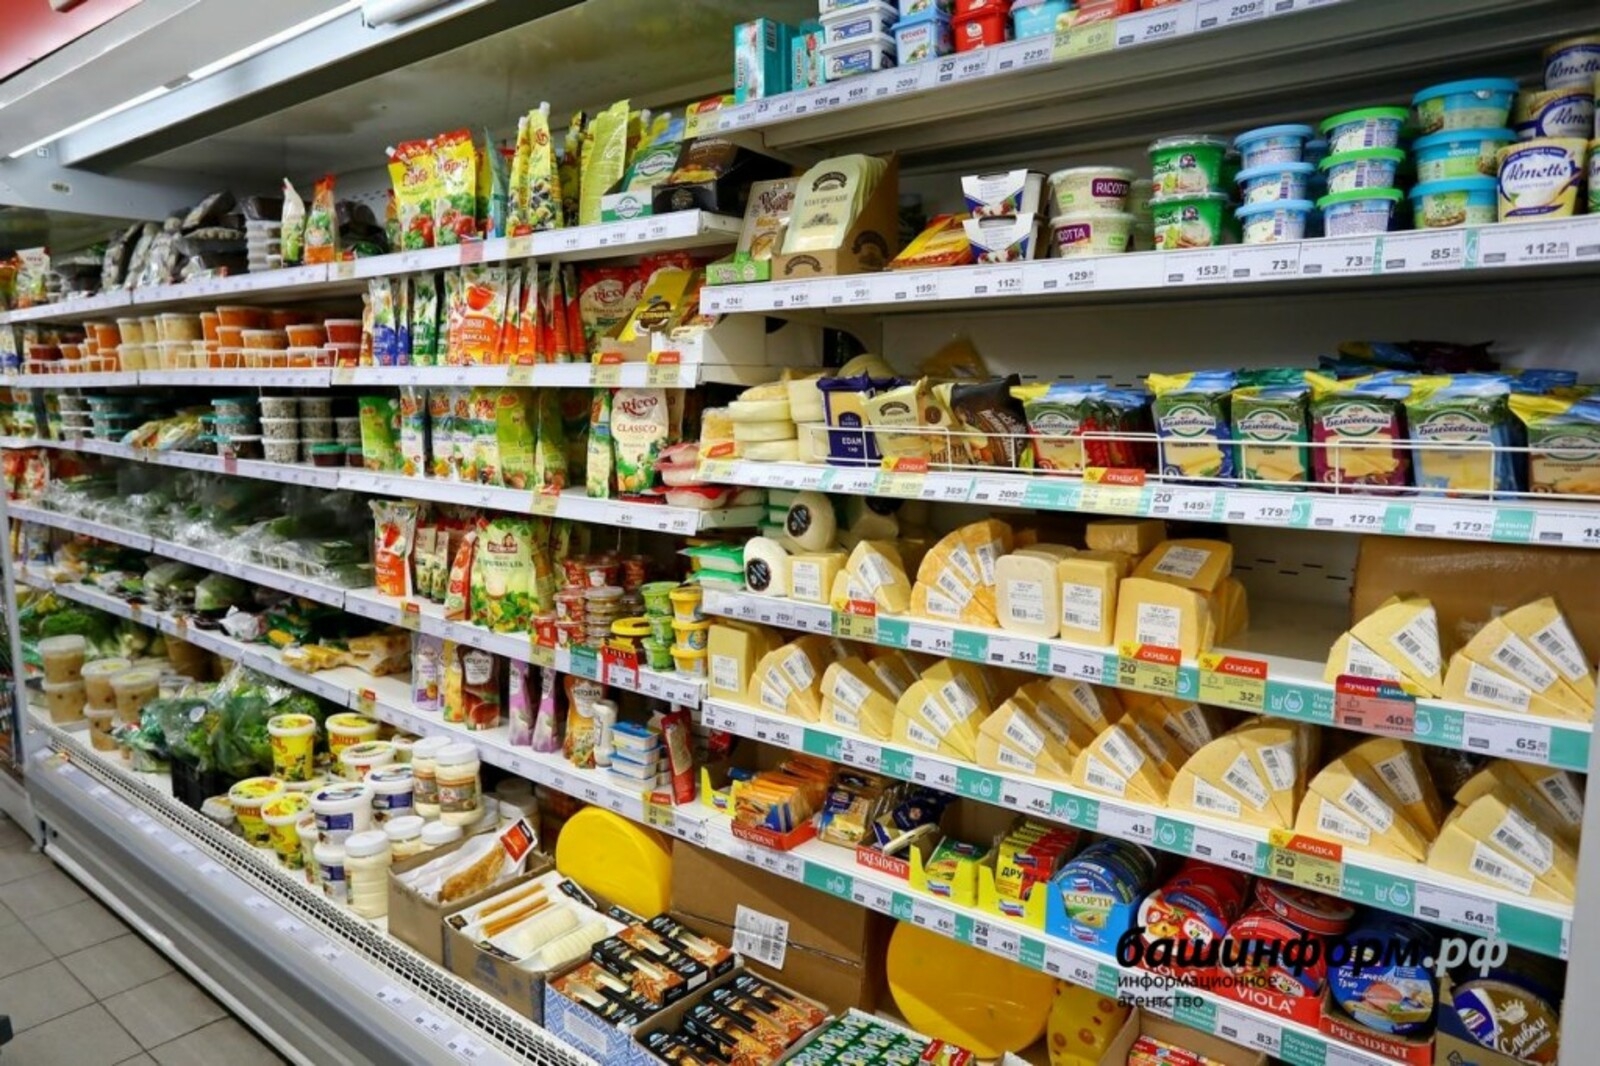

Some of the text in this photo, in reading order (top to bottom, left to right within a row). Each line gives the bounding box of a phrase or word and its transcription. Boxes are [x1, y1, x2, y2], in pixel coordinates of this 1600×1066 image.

[1504, 162, 1569, 182] Almette
[1430, 247, 1451, 260] 85
[1525, 242, 1558, 256] 112
[1272, 259, 1288, 271] 73
[1345, 255, 1363, 267] 73
[1418, 424, 1489, 436] Белебеевский
[1143, 650, 1176, 663] СКИДКА
[1119, 662, 1136, 674] 20
[1224, 662, 1261, 675] СКИДКА
[1516, 738, 1538, 750] 65
[1230, 849, 1247, 861] 64
[1296, 841, 1335, 856] СКИДКА
[1275, 853, 1295, 867] 20
[1464, 910, 1484, 923] 64
[1236, 985, 1292, 1015] VIOLA
[1256, 1032, 1273, 1045] 83
